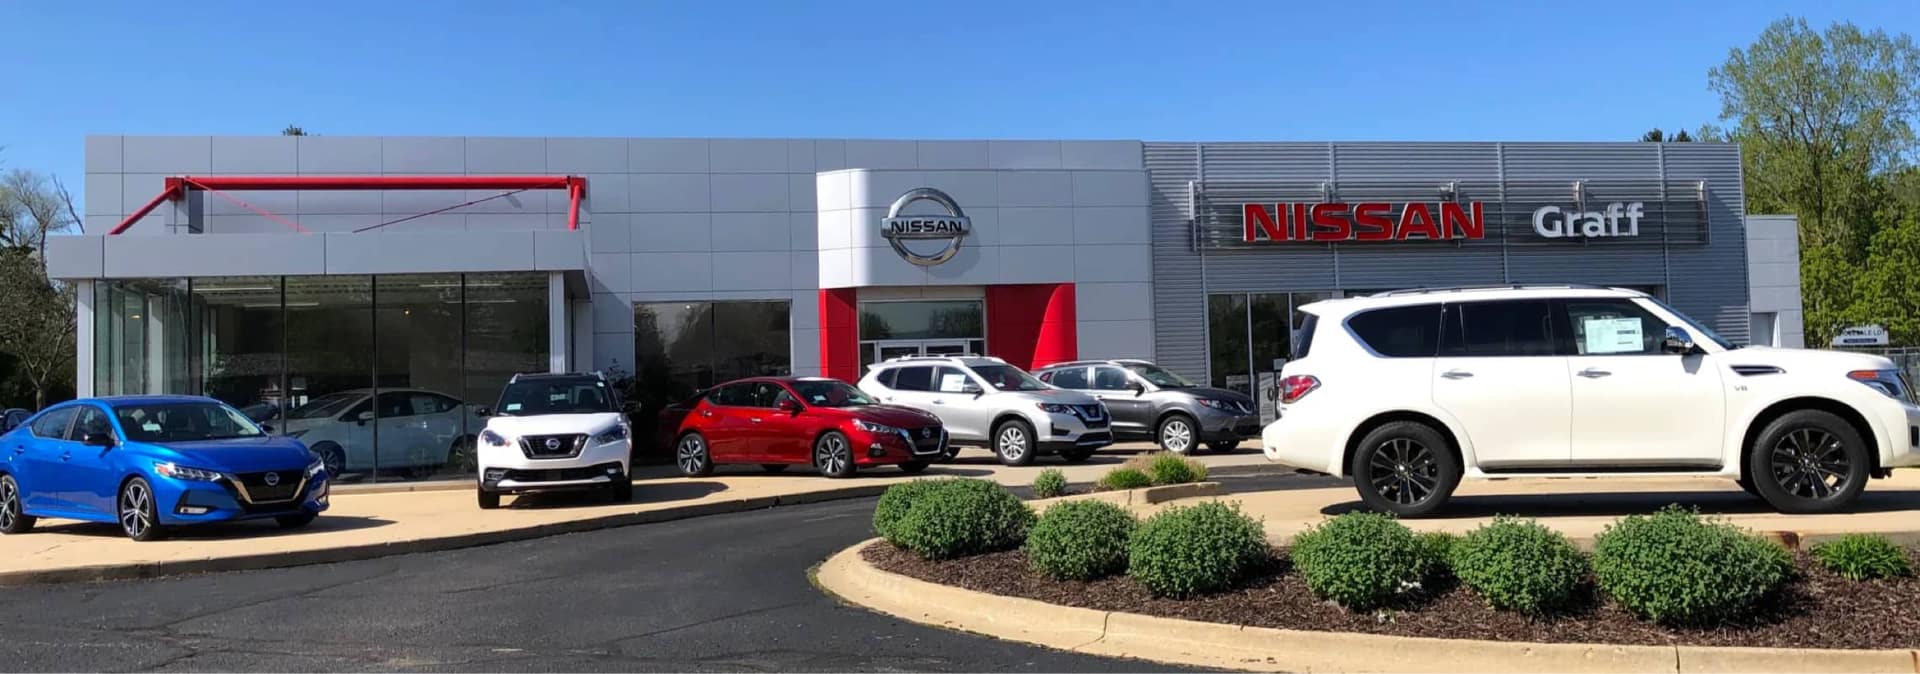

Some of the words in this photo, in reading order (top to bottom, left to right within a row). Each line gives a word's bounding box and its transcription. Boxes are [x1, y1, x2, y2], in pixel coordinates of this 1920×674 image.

[891, 220, 962, 233] NISSAN
[1243, 201, 1485, 242] NISSAN
[1532, 202, 1644, 238] Graff
